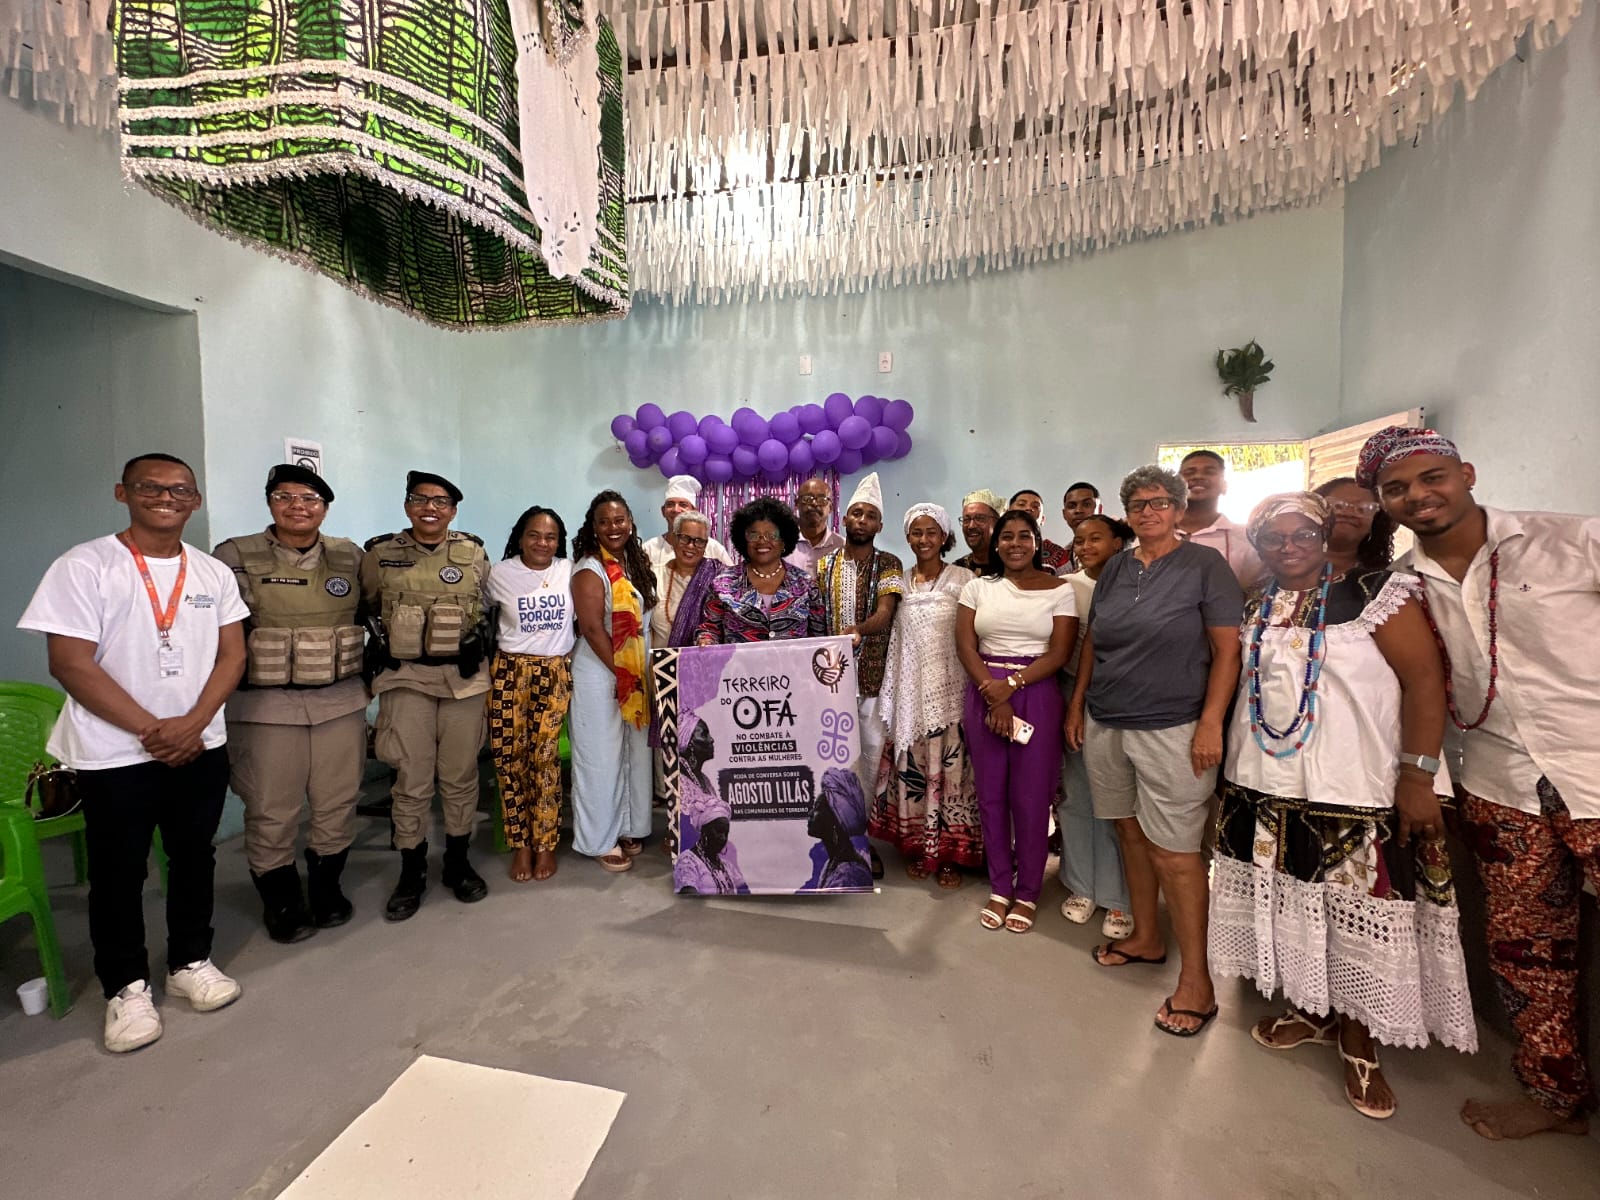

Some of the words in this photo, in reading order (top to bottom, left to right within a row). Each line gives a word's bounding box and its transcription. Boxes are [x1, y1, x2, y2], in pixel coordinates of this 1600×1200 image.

[518, 596, 536, 610] EU
[539, 594, 566, 608] SOU
[519, 608, 566, 623] PORQUE
[538, 622, 562, 631] SOMOS
[723, 675, 790, 693] TERREIRO
[733, 692, 797, 730] OFÁ
[734, 741, 794, 753] VIOLÊNCIAS
[728, 781, 772, 805] AGOSTO
[776, 778, 810, 803] LILÁS
